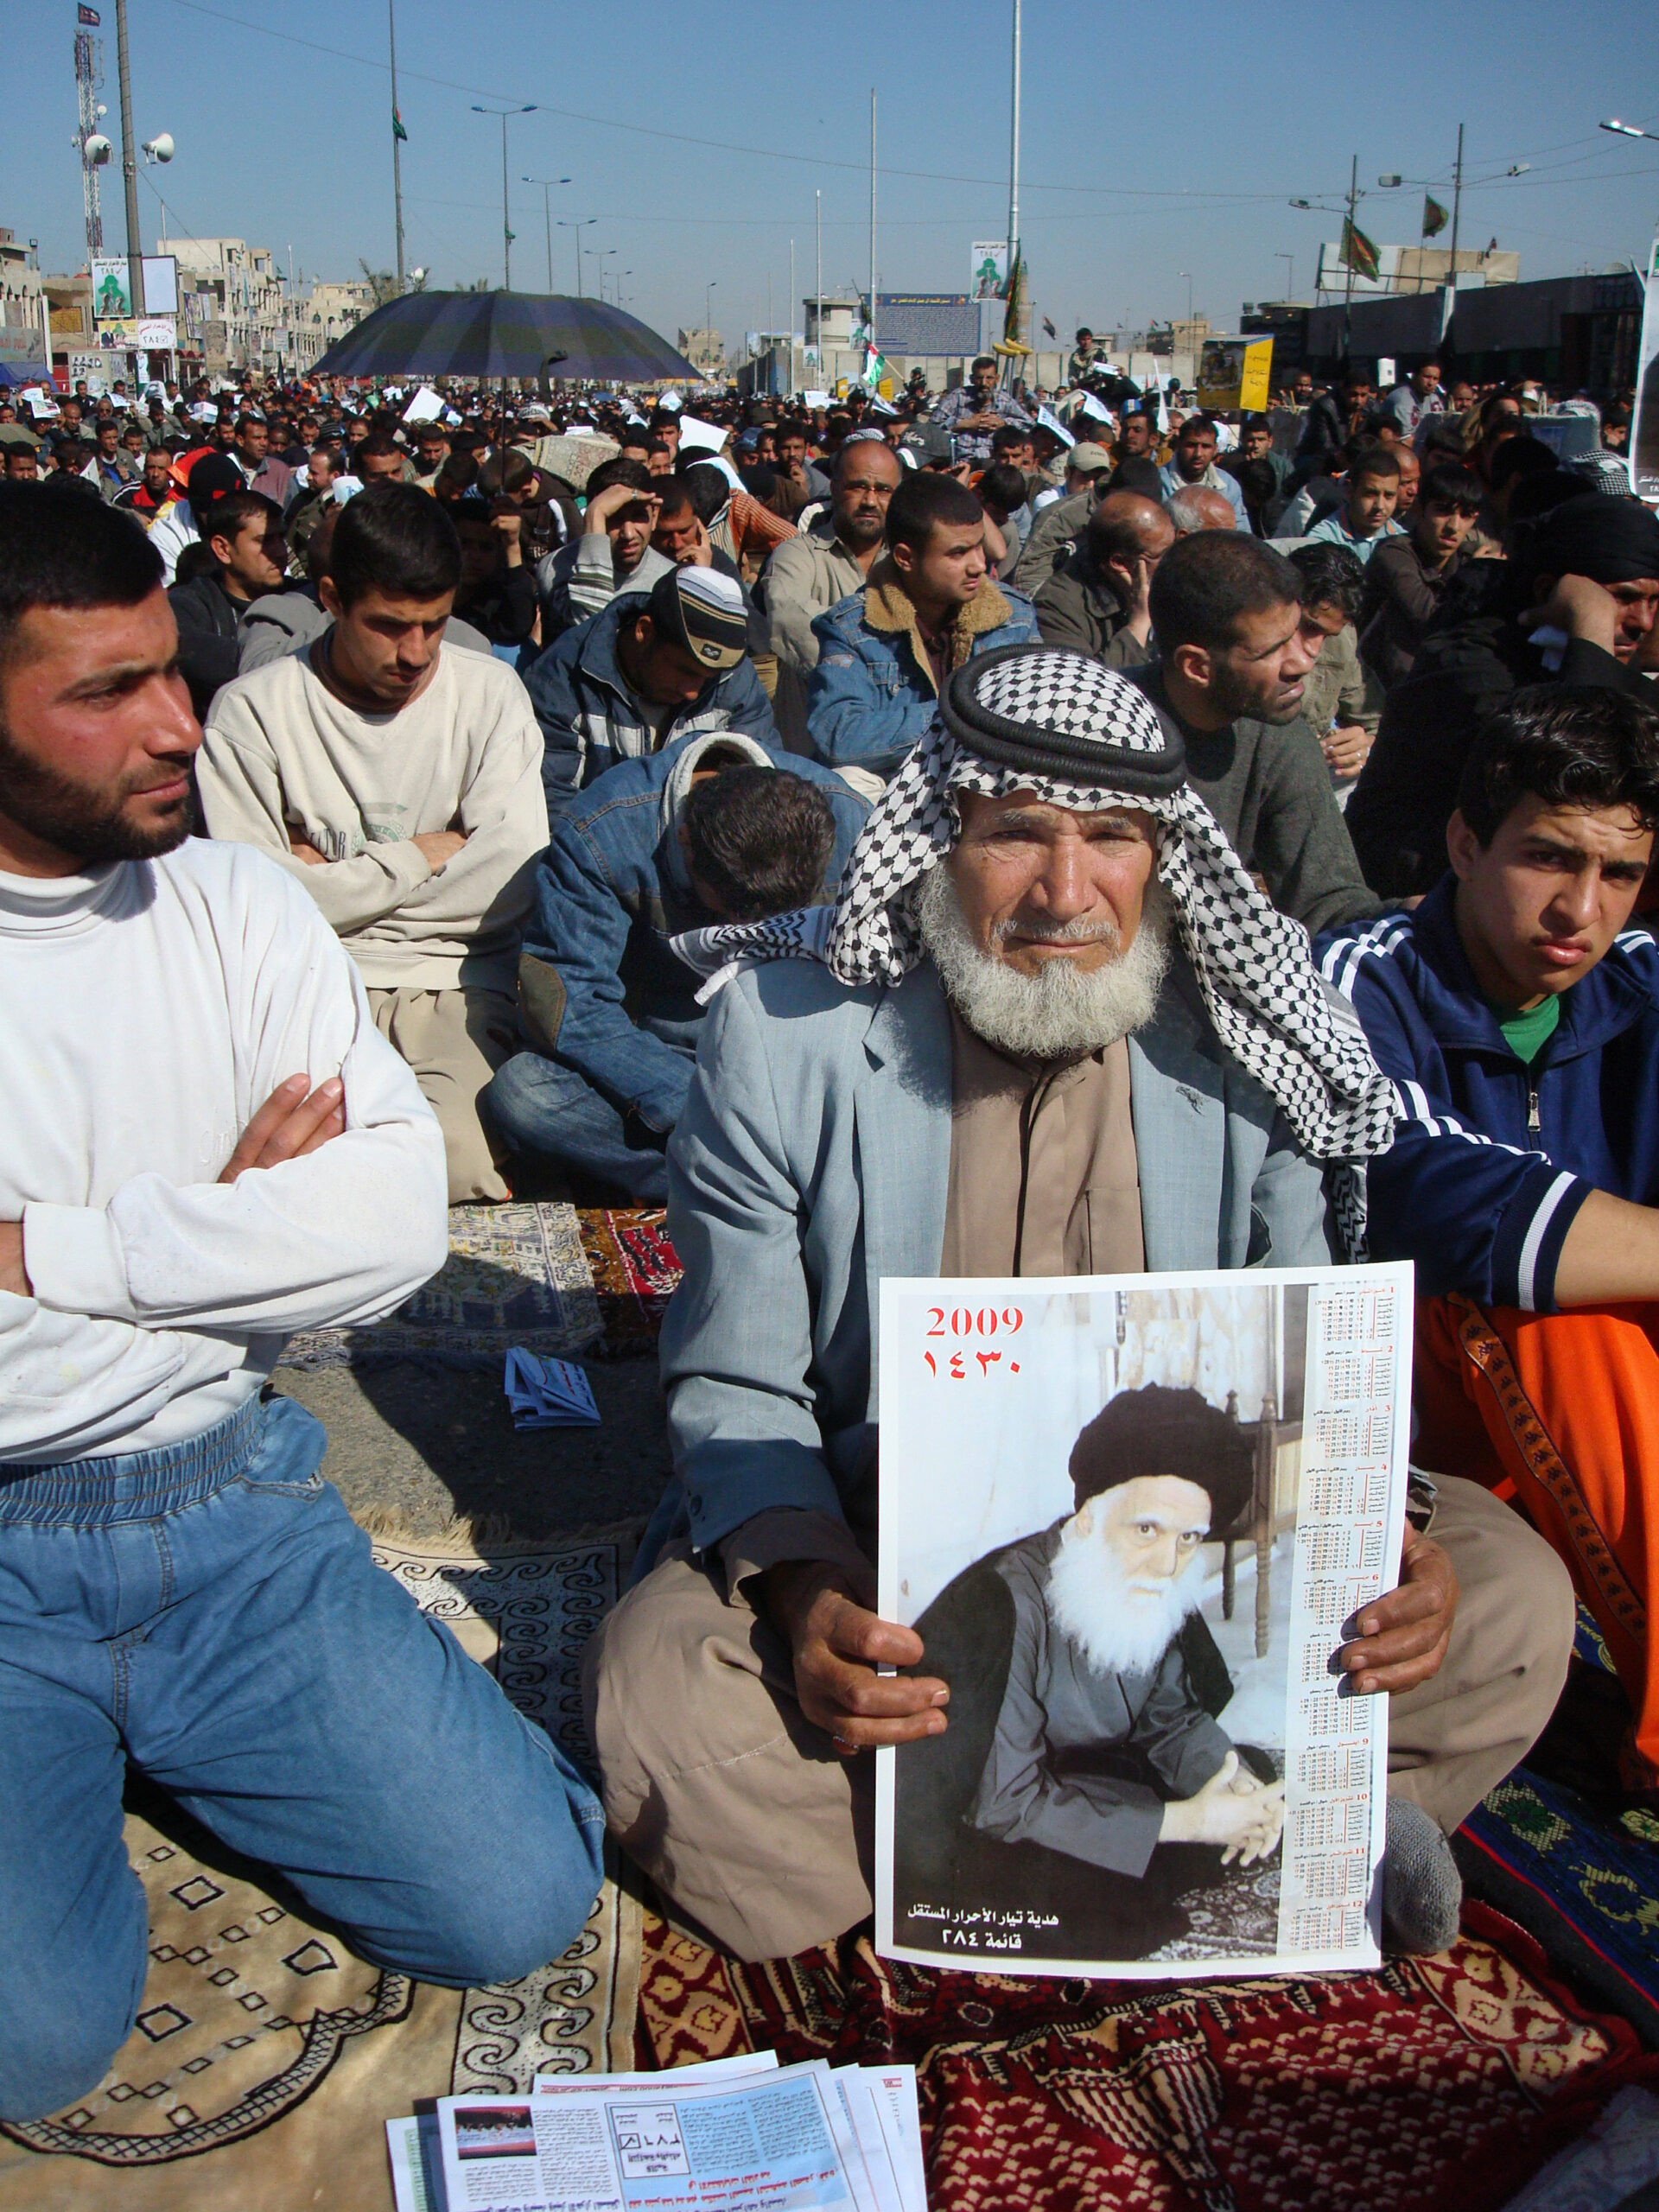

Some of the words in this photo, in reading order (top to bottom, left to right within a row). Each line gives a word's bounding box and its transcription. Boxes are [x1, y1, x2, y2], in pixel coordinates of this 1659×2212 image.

[926, 1307, 1023, 1336] 2009
[924, 1351, 1020, 1378] ١٤٣٠
[907, 1904, 950, 1920] المستقل
[951, 1907, 996, 1924] الأحرار
[997, 1910, 1023, 1927] تيار
[1027, 1910, 1059, 1929] هدية
[942, 1929, 979, 1947] ٢٨٤
[985, 1932, 1022, 1949] قائمة
[644, 2133, 681, 2145] ٣٧٦
[628, 2200, 642, 2209] لقد
[676, 2194, 697, 2204] بدعم
[701, 2193, 727, 2203] مكتب
[729, 2188, 753, 2200] السيد
[757, 2181, 787, 2195] الشهيد
[790, 2173, 814, 2189] الصدر
